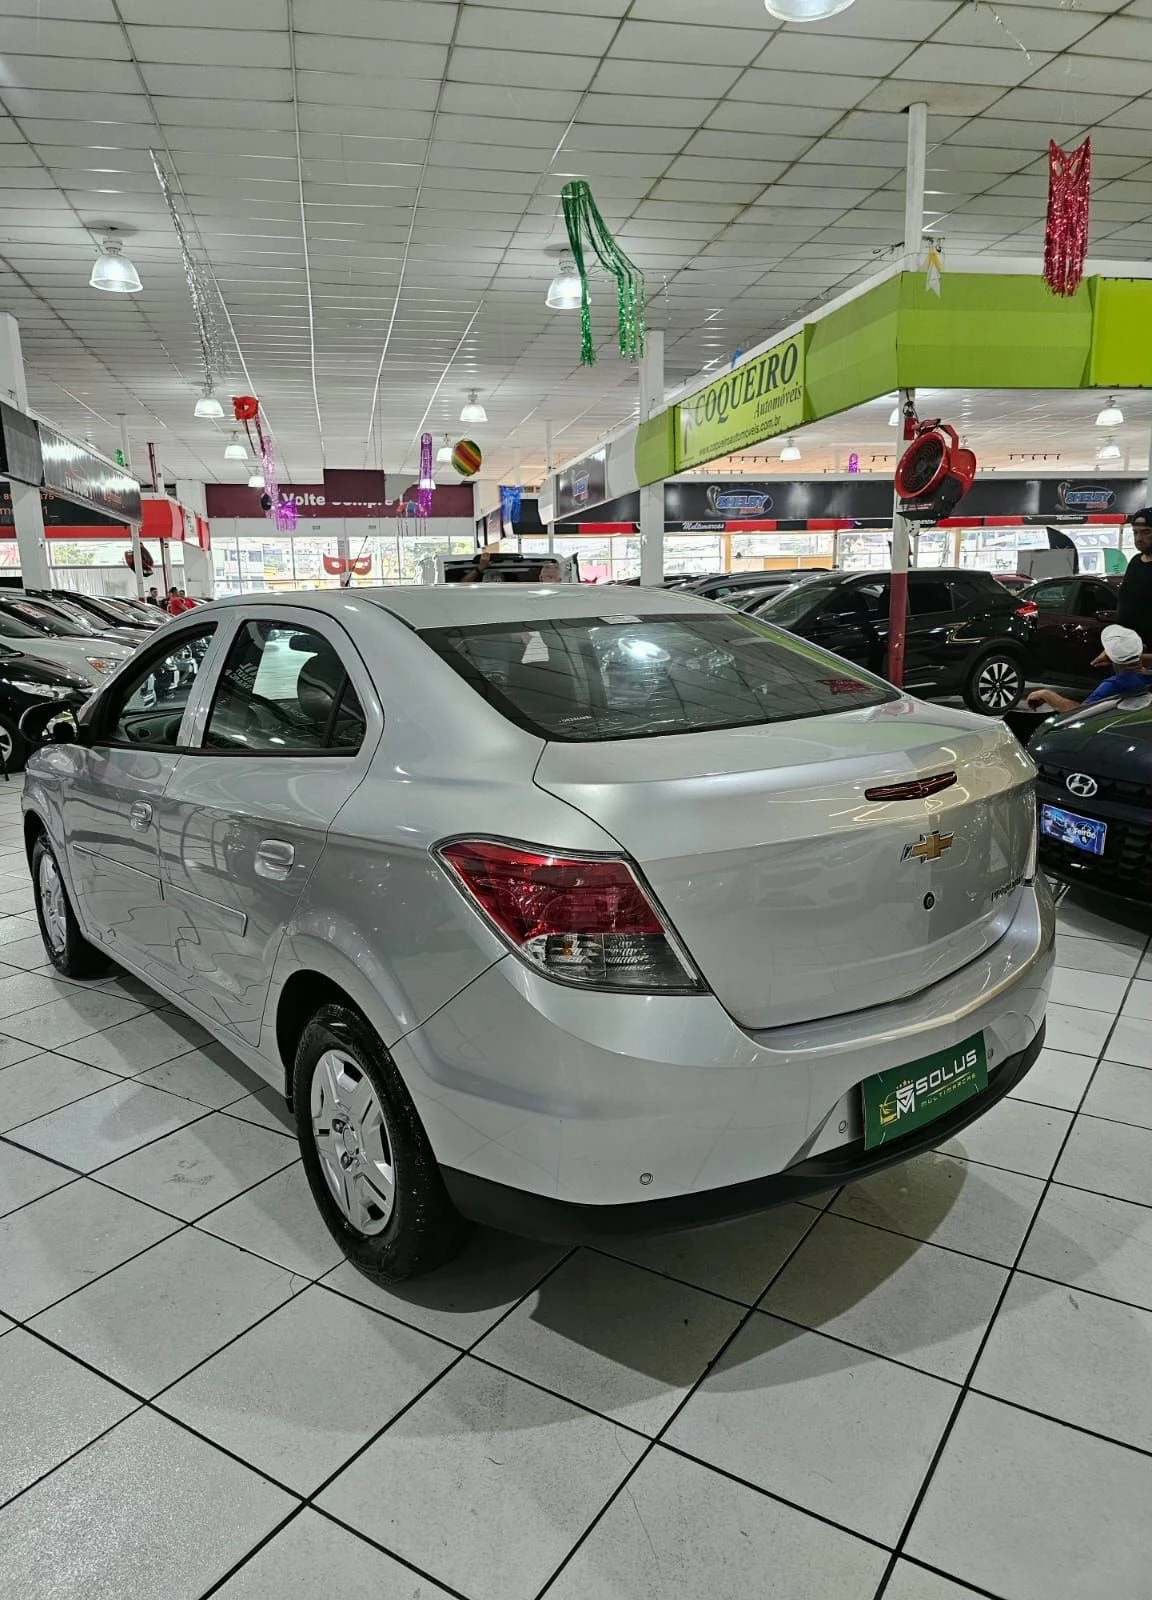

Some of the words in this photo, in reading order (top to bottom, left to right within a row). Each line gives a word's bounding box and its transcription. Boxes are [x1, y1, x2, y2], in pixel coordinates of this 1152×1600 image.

[695, 342, 798, 424] COQUEIRO
[753, 382, 802, 419] Automóveis
[281, 492, 326, 506] Volte
[716, 495, 769, 509] SHELBY
[915, 1049, 977, 1095] SOLUS
[921, 1073, 976, 1107] MULTIMARCAS
